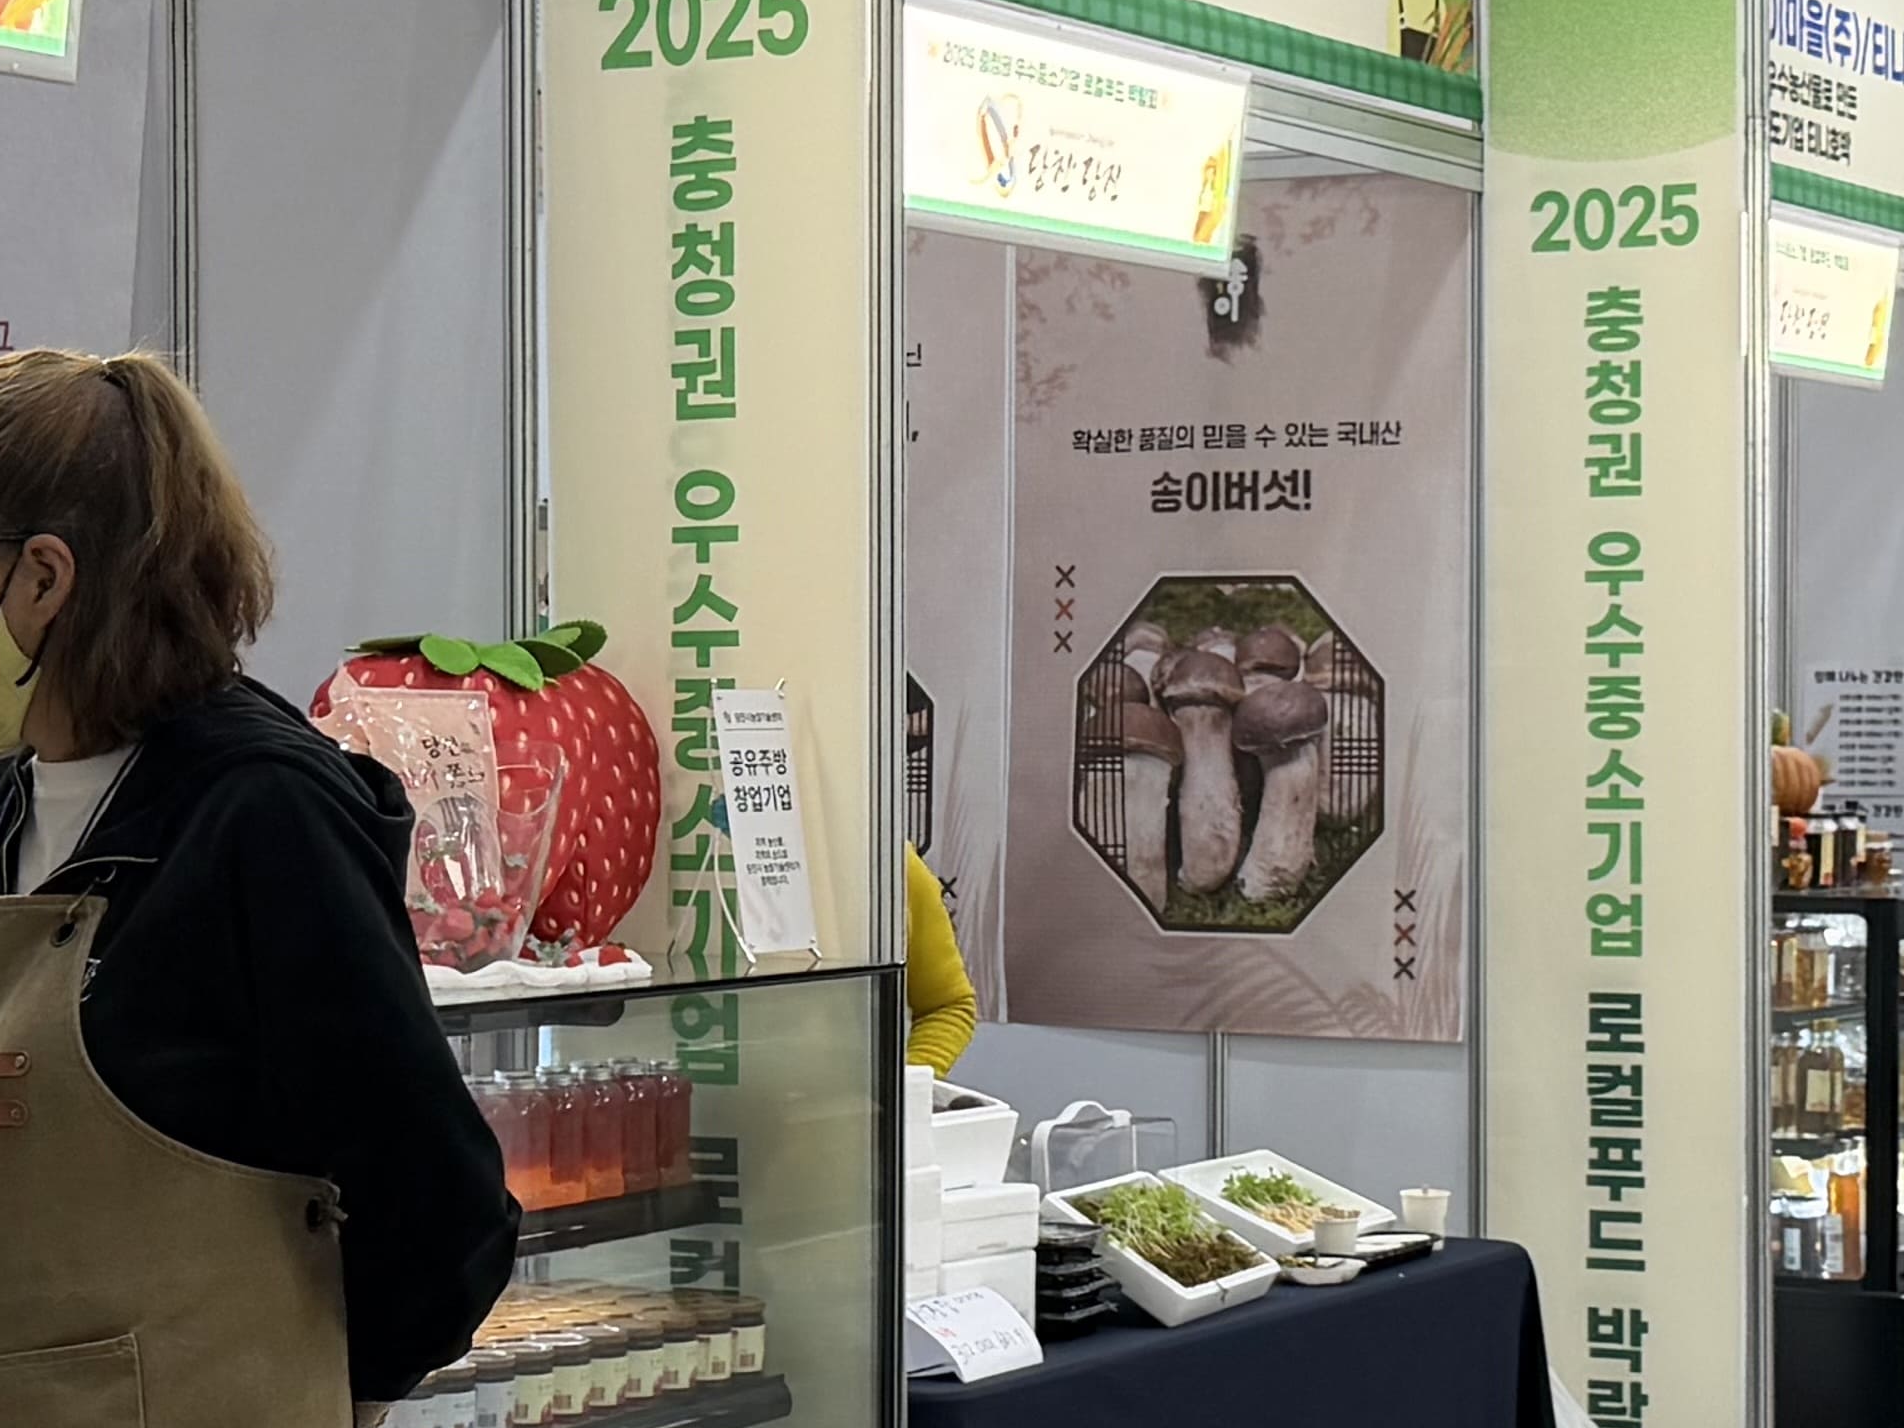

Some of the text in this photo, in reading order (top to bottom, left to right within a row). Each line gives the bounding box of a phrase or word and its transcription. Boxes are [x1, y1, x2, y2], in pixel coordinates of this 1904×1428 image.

[1530, 183, 1699, 253] 2025
[669, 114, 738, 423] 충청권
[1584, 286, 1644, 498] 충청권
[1072, 420, 1401, 454] 확실한 품질의 믿을 수 있는 국내산
[1151, 469, 1311, 514] 송이버섯!
[729, 748, 787, 777] 공유주방
[1584, 532, 1645, 958] 우수중소기업
[733, 783, 792, 813] 창업기업
[1586, 992, 1645, 1272] 로컬푸드
